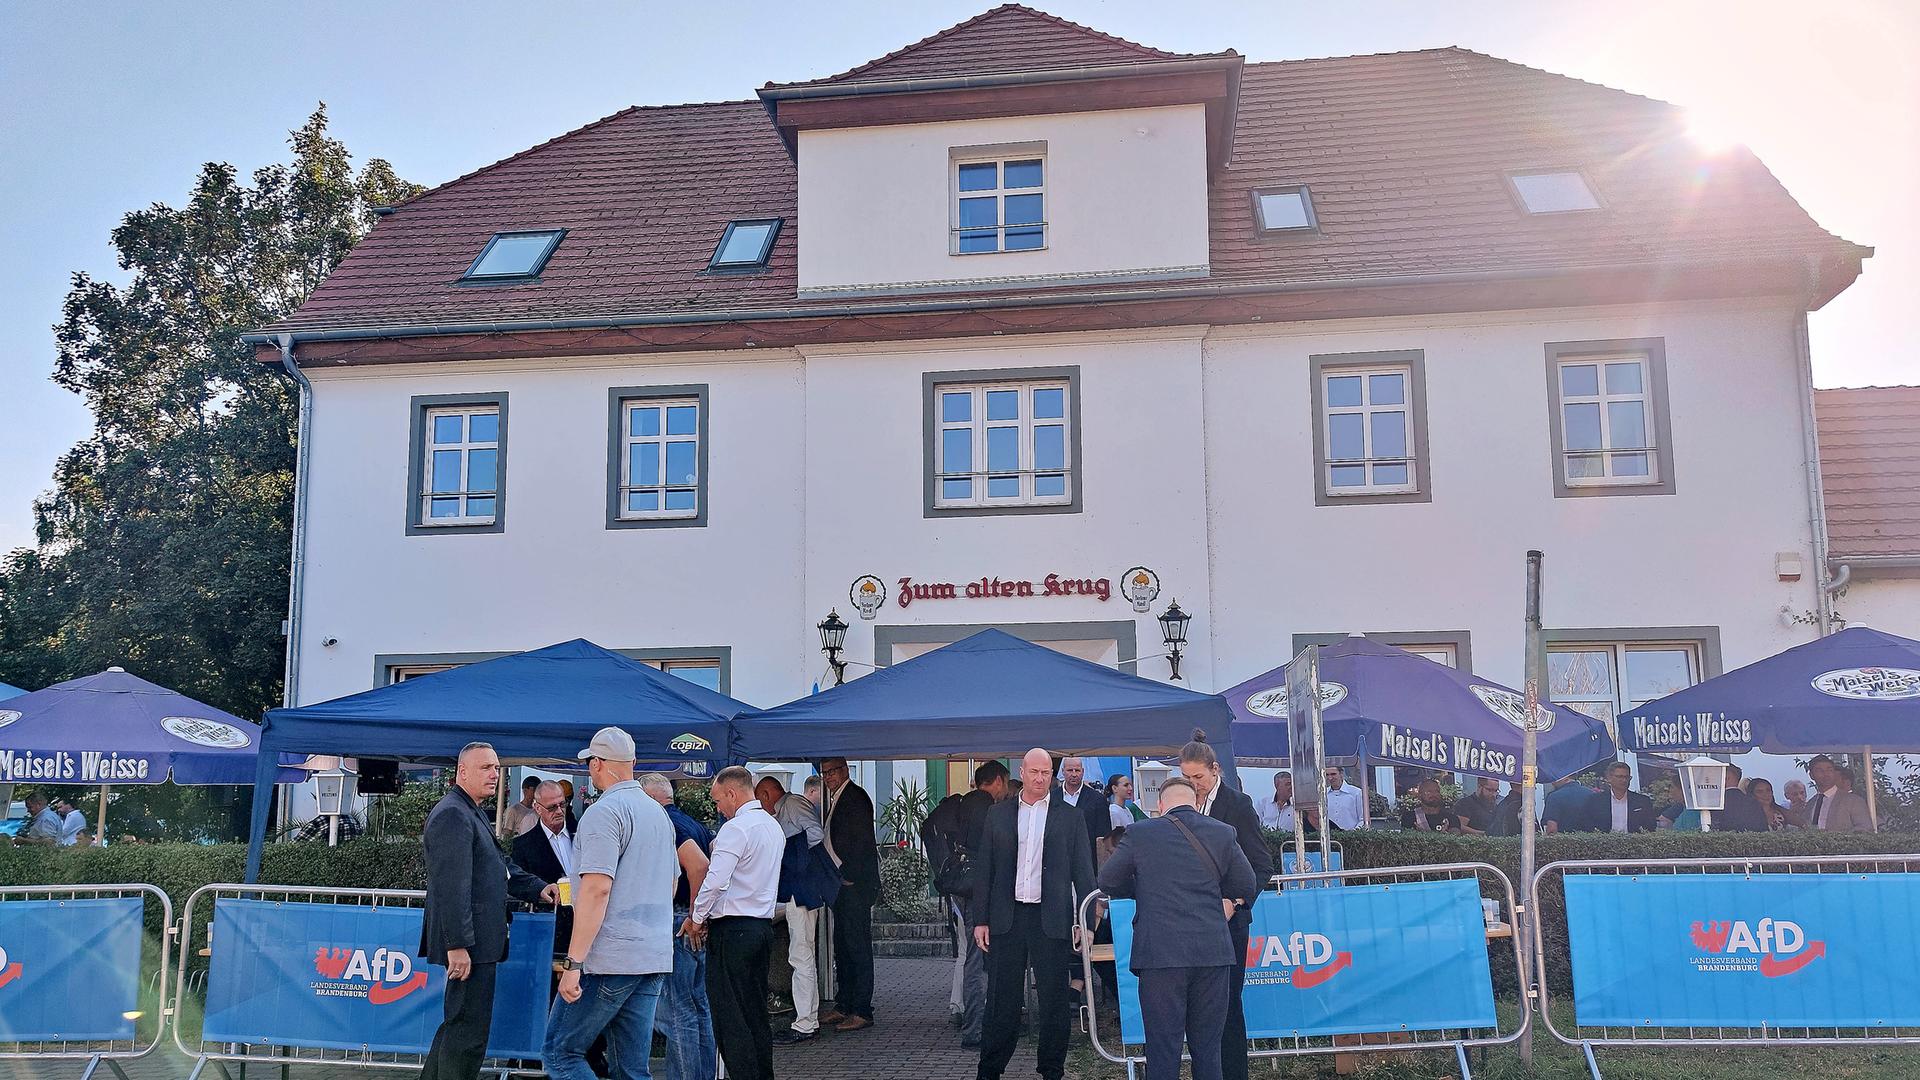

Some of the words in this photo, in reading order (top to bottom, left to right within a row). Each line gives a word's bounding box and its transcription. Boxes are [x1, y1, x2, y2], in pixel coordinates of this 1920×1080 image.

[897, 577, 957, 608] Zum
[966, 575, 1034, 598] alten
[1042, 573, 1111, 601] Krug
[671, 742, 705, 750] COBIZI
[1633, 714, 1693, 749] Maisel's
[1696, 712, 1752, 747] Weisse
[81, 751, 149, 781] Weisse
[1381, 723, 1448, 765] Maisel's
[1453, 736, 1517, 777] Weisse
[1261, 931, 1333, 967] AfD
[1726, 917, 1805, 953] AfD
[343, 947, 412, 983] AfD
[1244, 977, 1290, 985] ANDENBURG
[1245, 970, 1290, 979] ESVERBAND
[310, 982, 368, 990] LANDESVERBAND
[316, 990, 368, 998] BRANDENBURG
